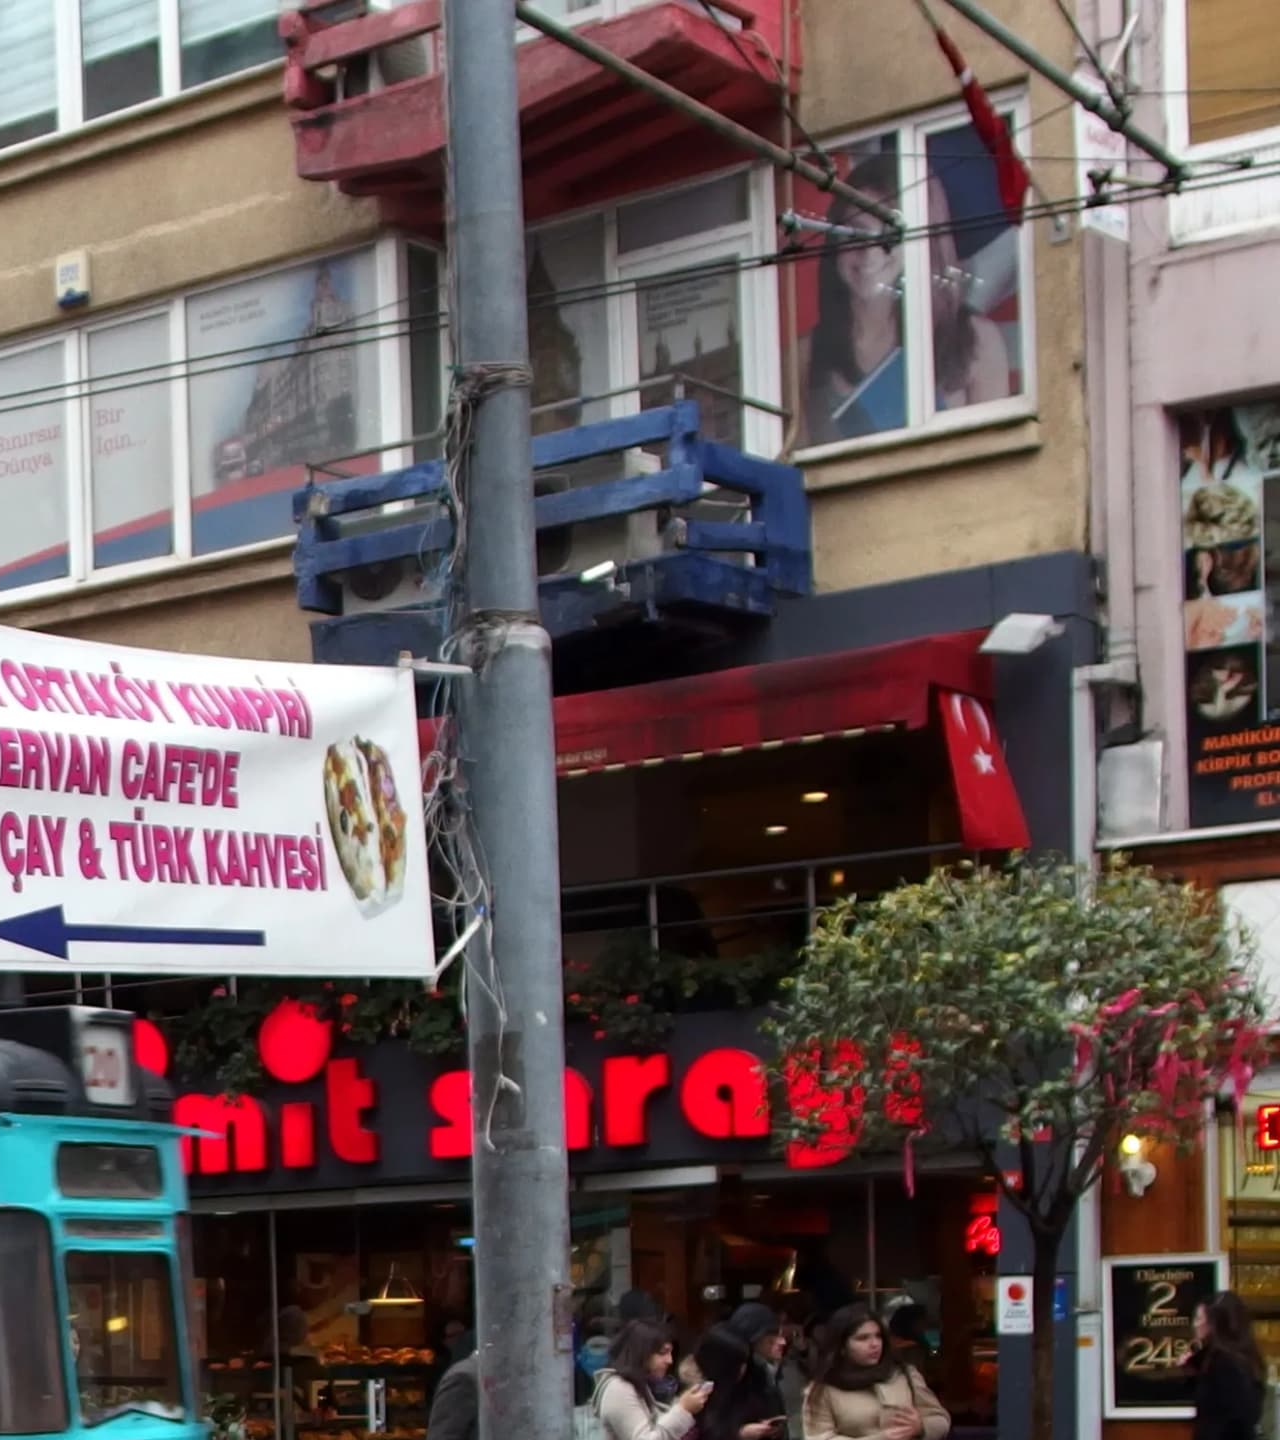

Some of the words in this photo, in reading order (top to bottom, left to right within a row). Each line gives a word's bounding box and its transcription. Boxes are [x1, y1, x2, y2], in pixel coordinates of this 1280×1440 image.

[2, 660, 169, 724] ORTAKÖY
[169, 674, 315, 740] KUMPİRİ
[120, 743, 240, 808] CAFE'DE
[0, 811, 66, 893] ÇAY
[78, 817, 105, 880] &
[110, 807, 200, 884] TÜRK
[203, 822, 328, 892] KAHVESİ
[132, 1000, 381, 1176] mit
[1149, 1281, 1179, 1314] 2
